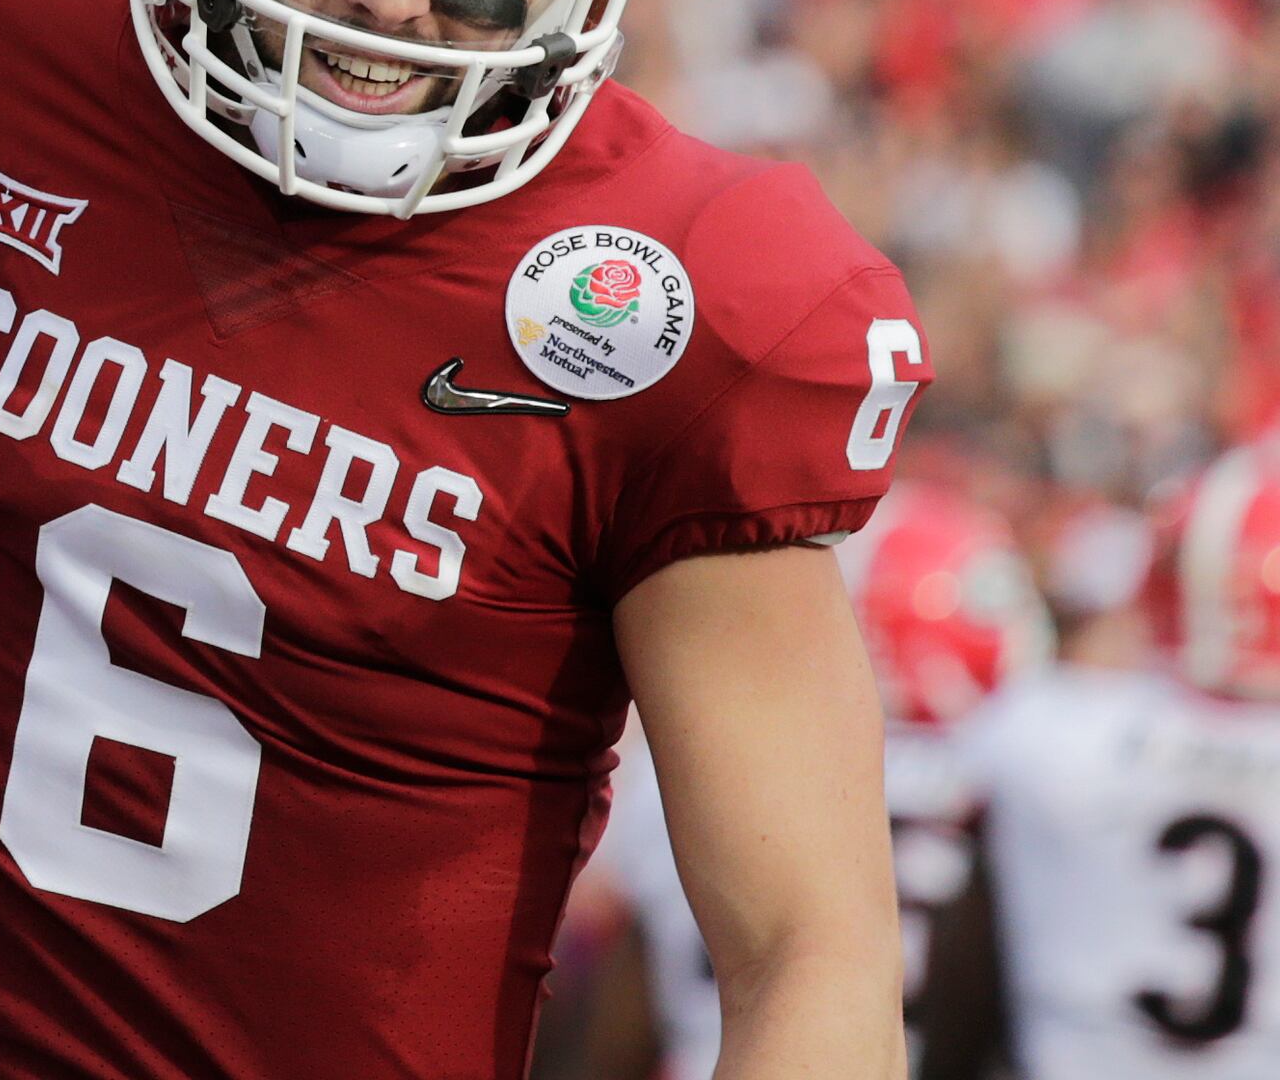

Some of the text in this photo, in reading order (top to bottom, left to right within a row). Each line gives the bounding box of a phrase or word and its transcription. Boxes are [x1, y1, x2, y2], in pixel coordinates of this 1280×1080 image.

[523, 232, 685, 357] ROSE BOWL GAME
[548, 315, 616, 357] presented by
[546, 333, 635, 388] Northwestern
[846, 318, 922, 470] 6
[1132, 813, 1264, 1045] 3
